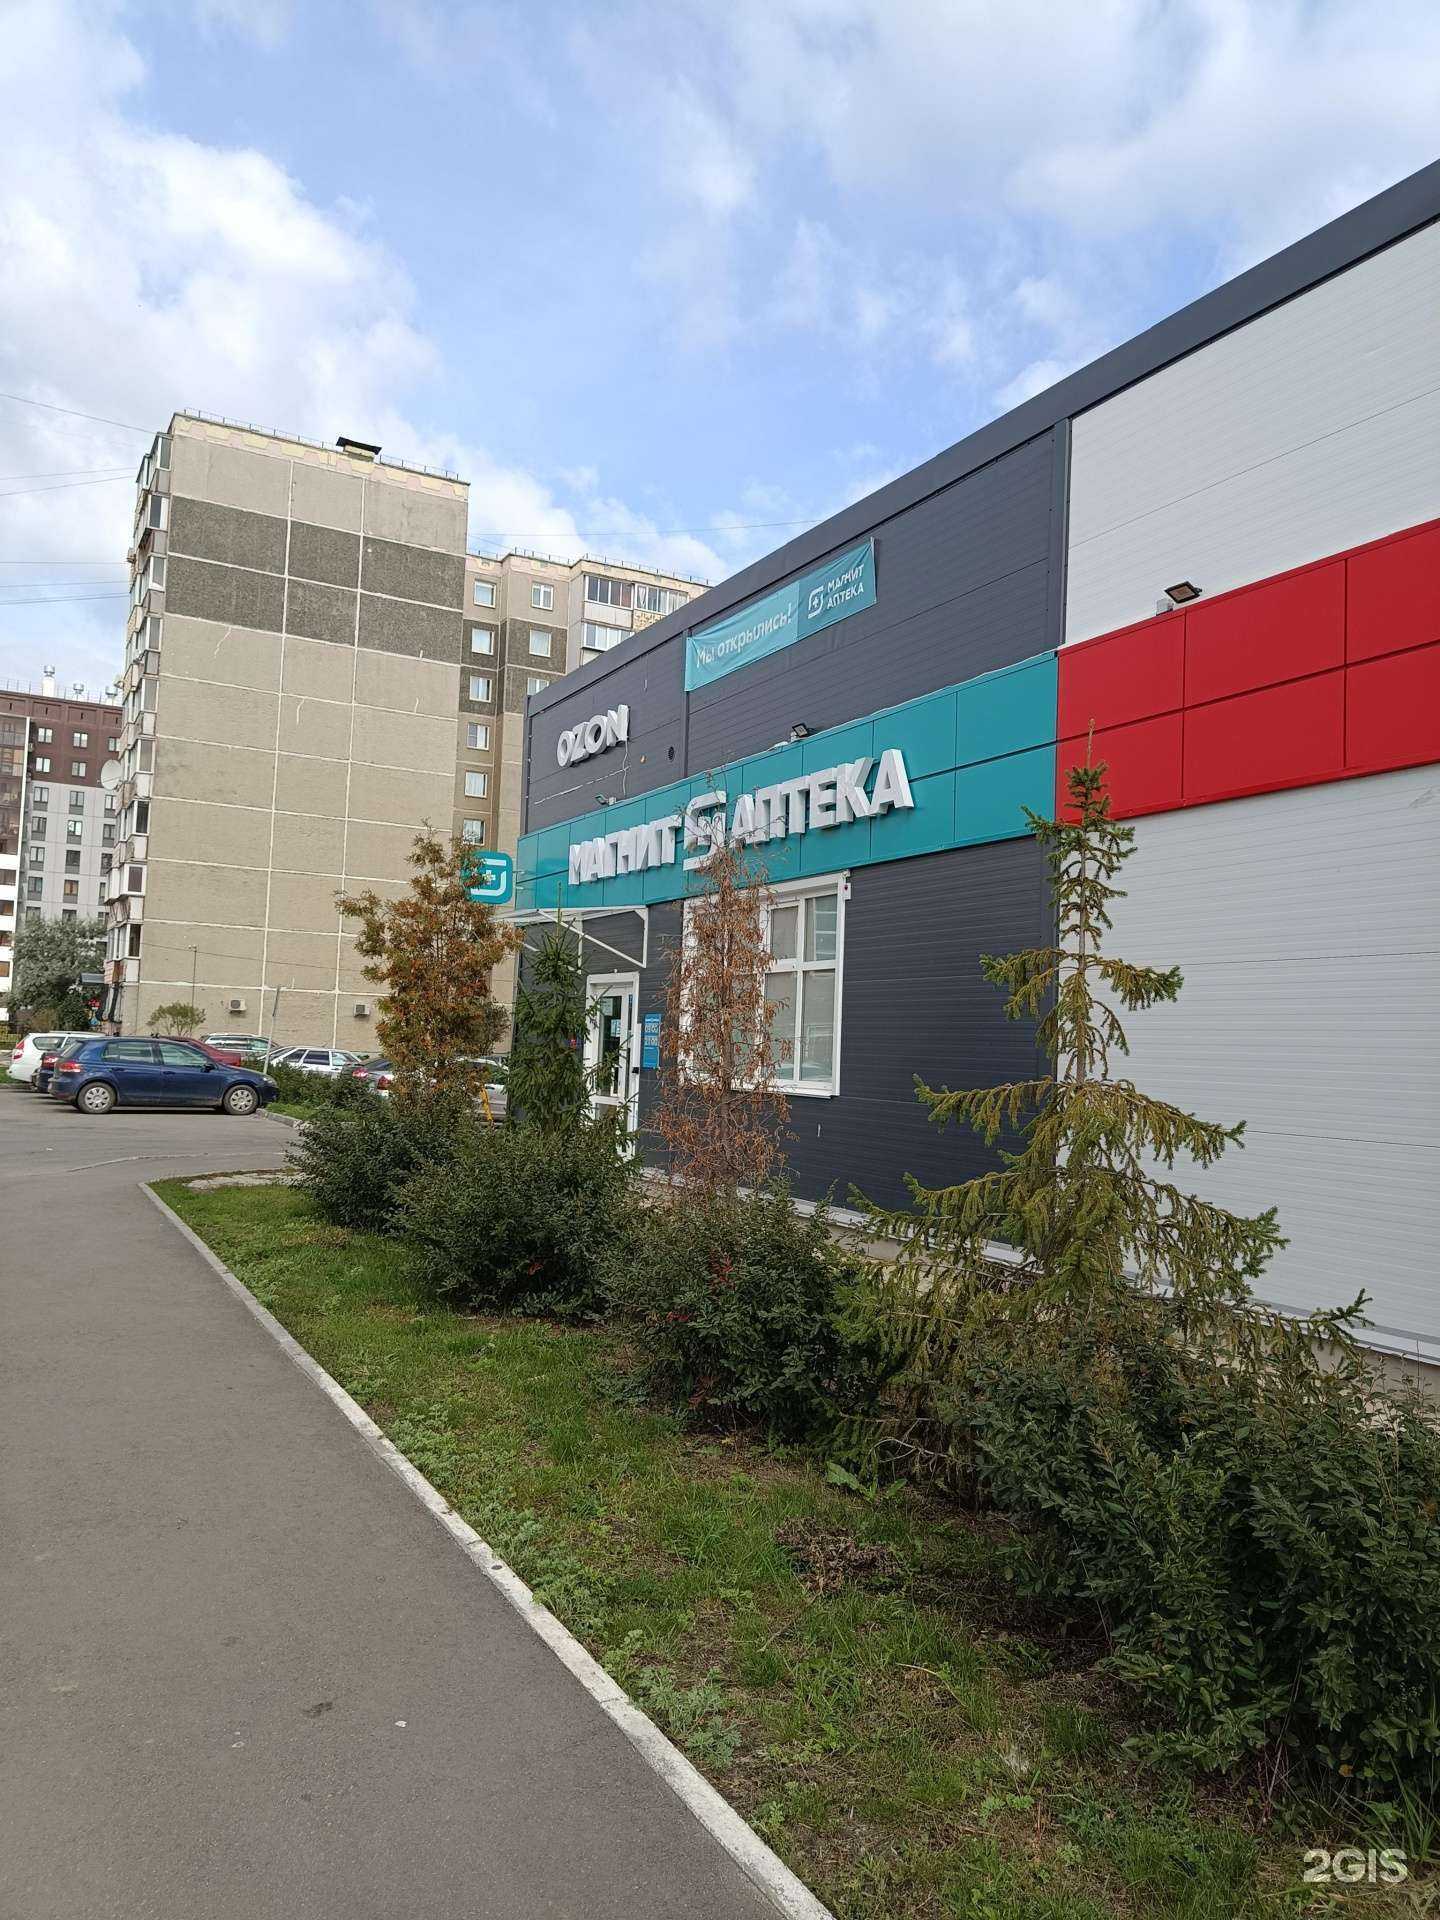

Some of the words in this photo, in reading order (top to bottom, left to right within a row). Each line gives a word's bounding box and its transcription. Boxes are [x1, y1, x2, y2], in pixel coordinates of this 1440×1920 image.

[827, 564, 864, 593] МАГНИТ
[827, 584, 864, 610] АПТЕКА
[696, 645, 715, 668] Мы
[717, 603, 792, 657] открылись!
[557, 704, 629, 767] OZON
[568, 814, 682, 885] МАГНИТ
[730, 749, 914, 848] АПТЕКА
